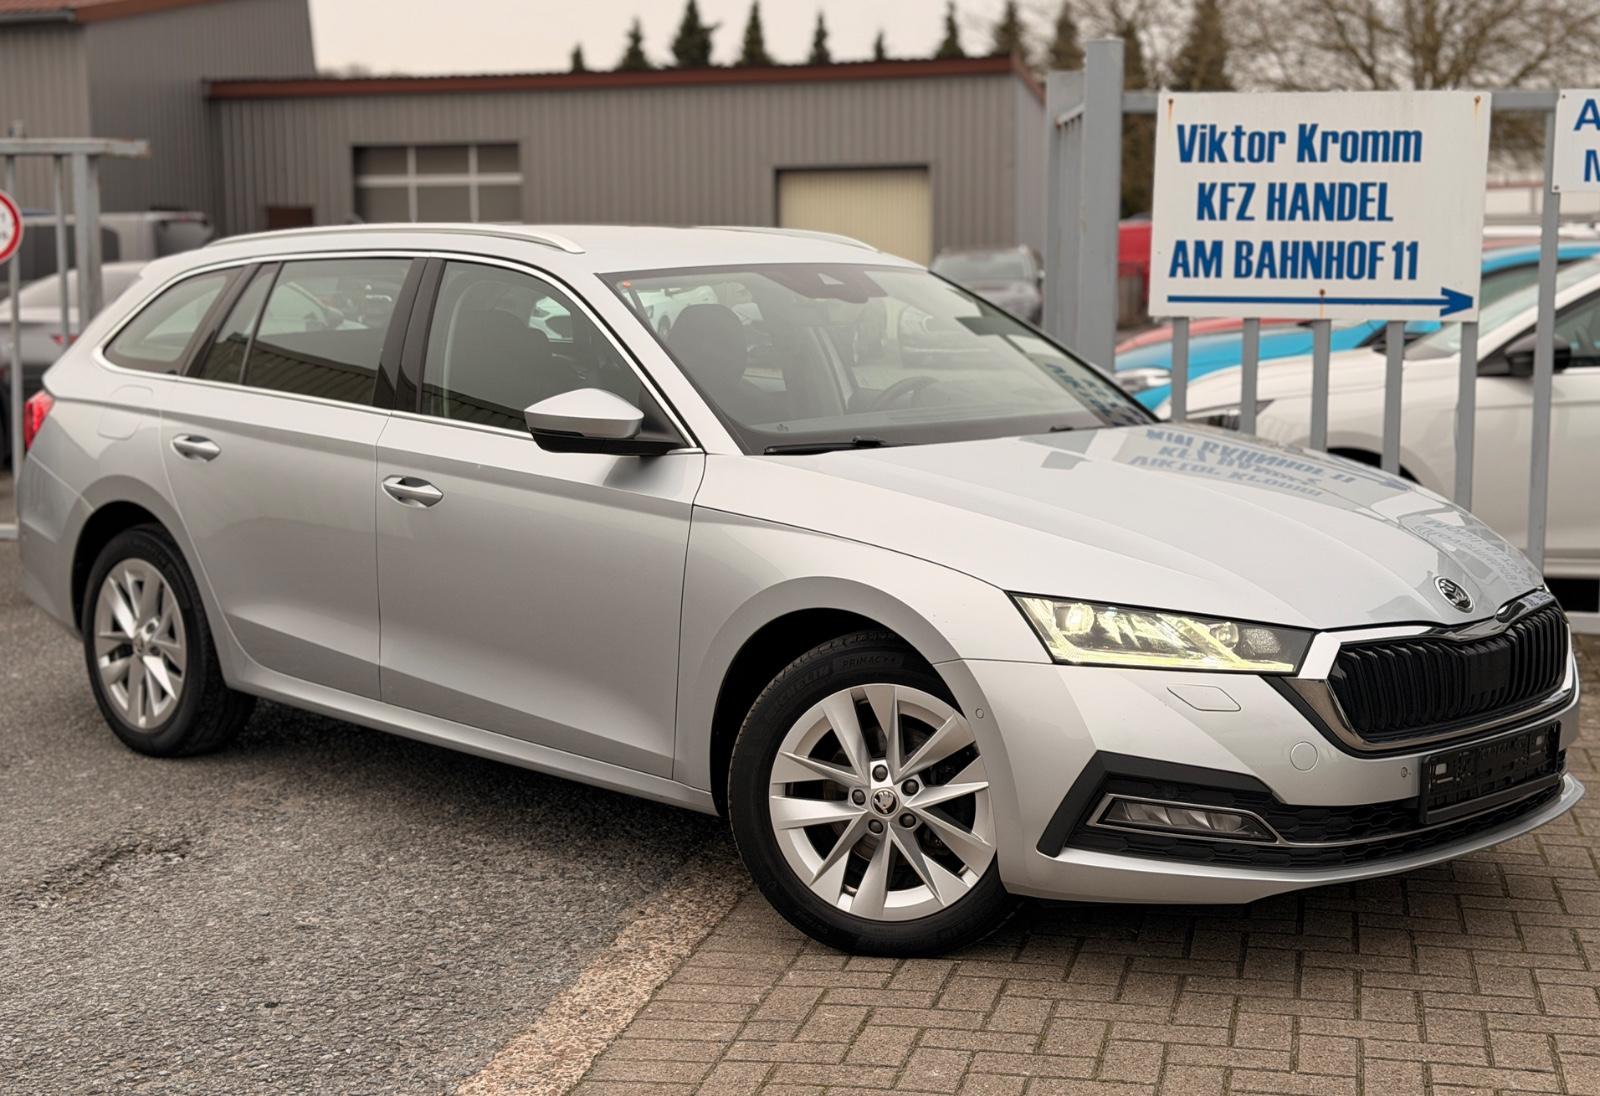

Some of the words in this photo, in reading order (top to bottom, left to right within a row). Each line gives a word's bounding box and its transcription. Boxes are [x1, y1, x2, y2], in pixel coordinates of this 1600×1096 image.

[1177, 124, 1286, 163] Viktor
[1298, 124, 1422, 163] Kromm
[1197, 183, 1255, 221] KFZ
[1267, 183, 1393, 221] HANDEL
[1170, 240, 1223, 278] AM
[1234, 241, 1385, 280] BAHNHOF
[1393, 241, 1418, 280] 11
